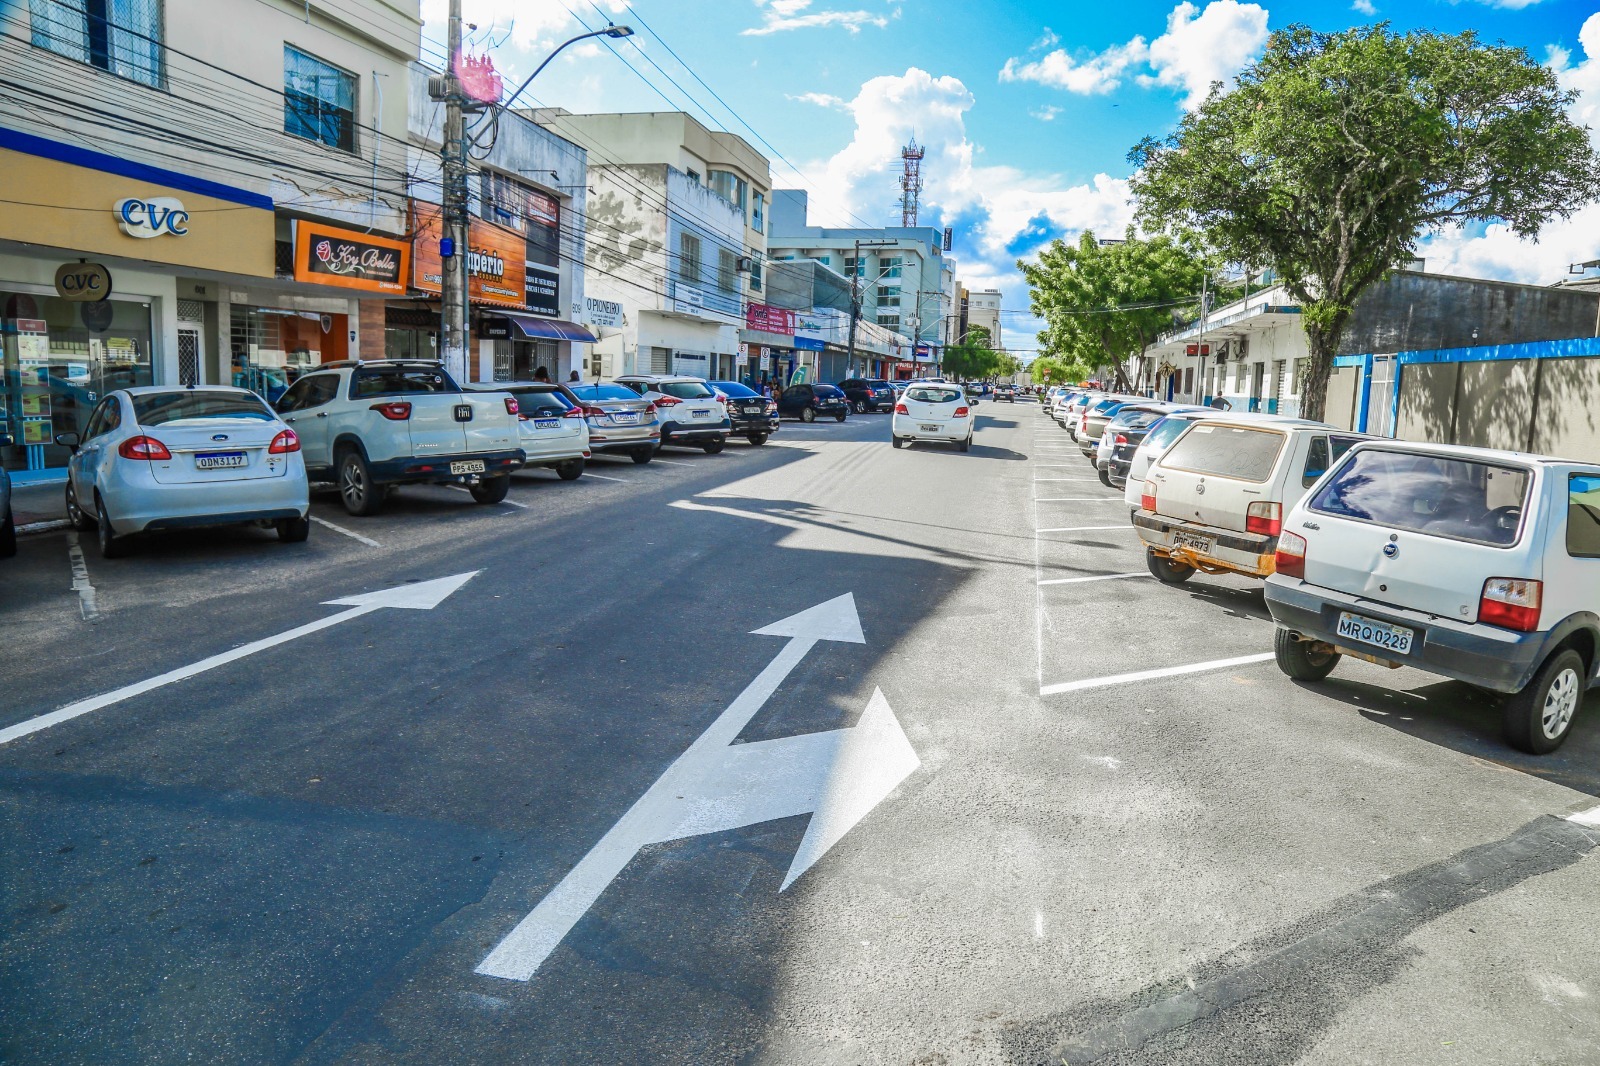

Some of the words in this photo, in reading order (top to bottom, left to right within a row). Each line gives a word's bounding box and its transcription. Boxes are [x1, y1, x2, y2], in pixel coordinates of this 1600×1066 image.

[121, 199, 189, 235] CVC
[361, 248, 395, 270] Bella
[467, 249, 504, 277] mpério
[62, 274, 101, 290] CVC
[587, 298, 592, 311] O
[593, 299, 620, 315] PIONEIRO
[200, 456, 243, 467] ODN3117
